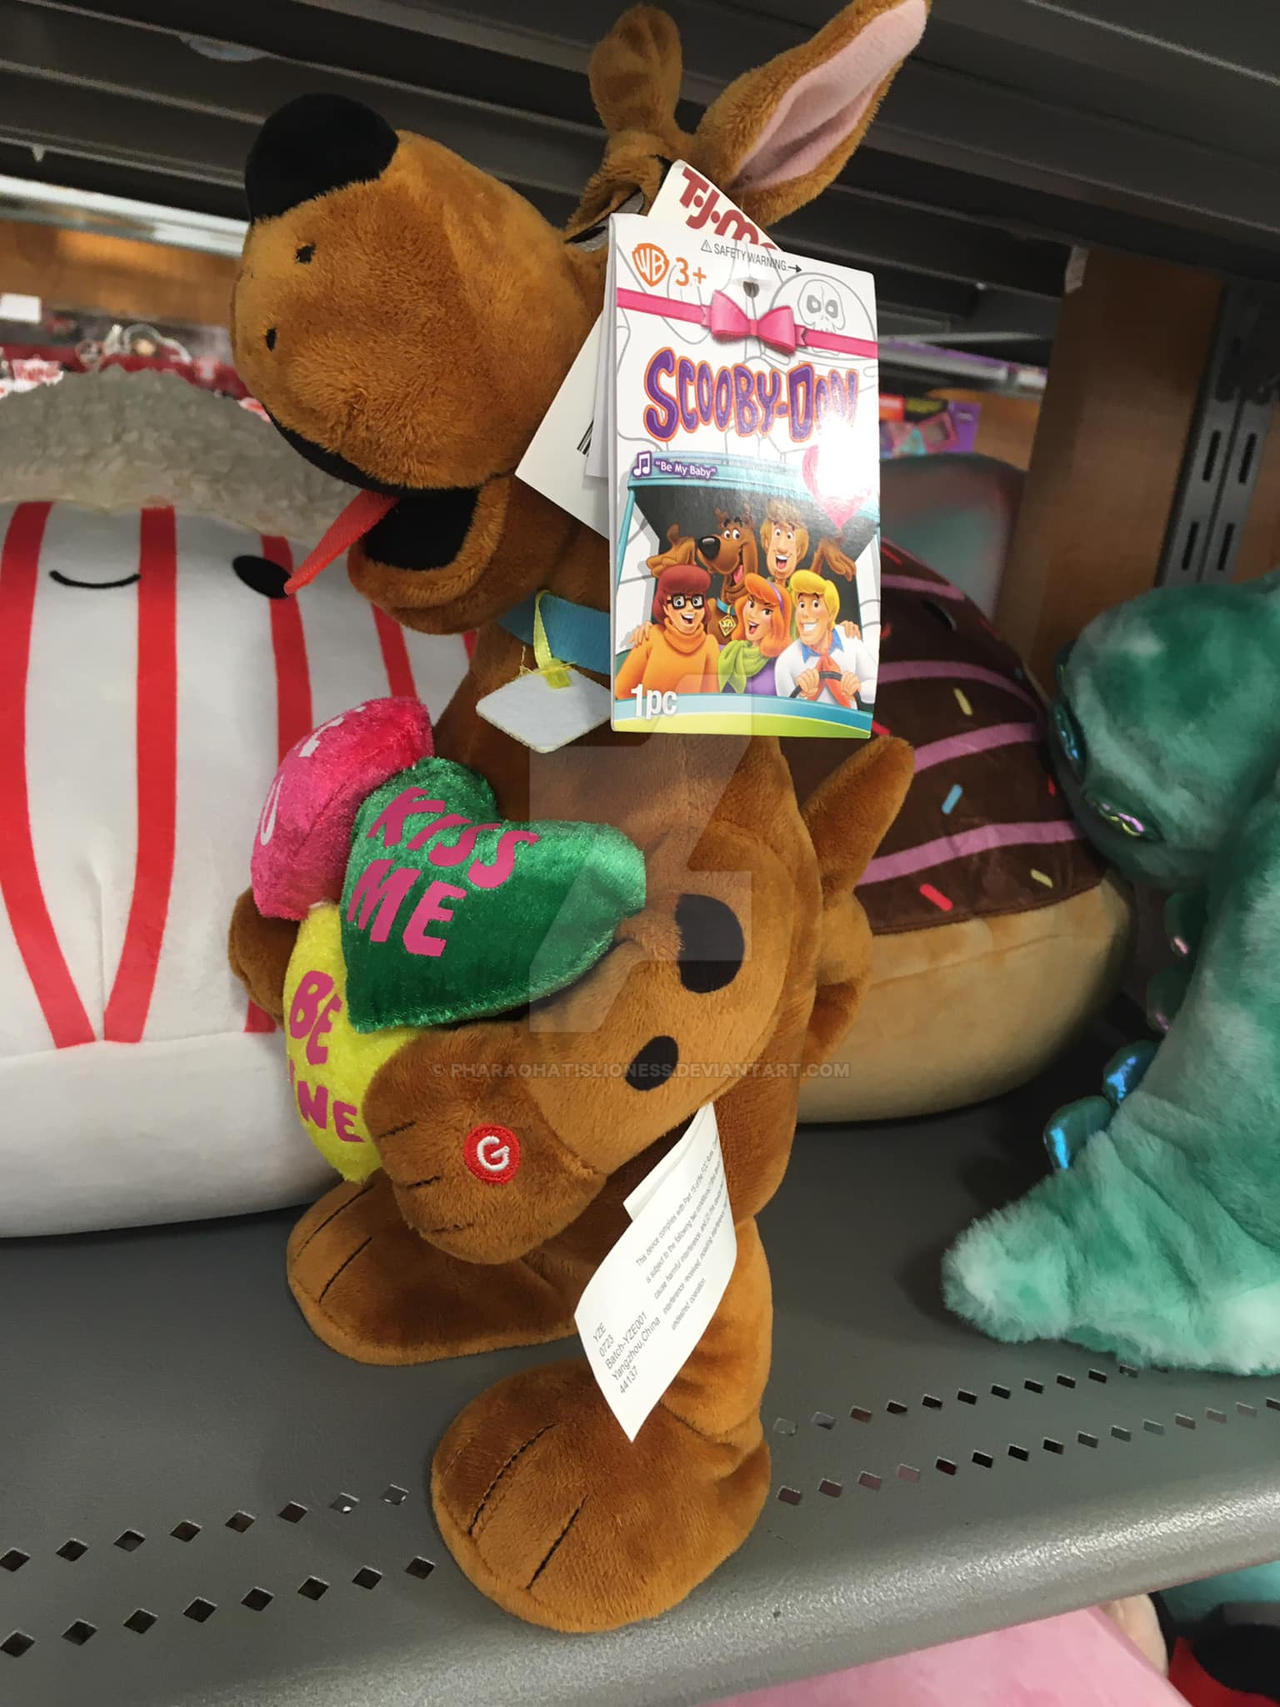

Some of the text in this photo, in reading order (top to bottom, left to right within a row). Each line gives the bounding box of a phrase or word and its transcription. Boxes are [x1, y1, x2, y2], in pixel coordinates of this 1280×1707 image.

[634, 245, 667, 285] WB
[675, 257, 707, 286] 3+
[714, 243, 787, 271] SAFETY WARNING
[674, 464, 687, 476] My
[631, 684, 677, 720] 1pc
[366, 786, 539, 890] KISS
[345, 858, 468, 958] ME
[289, 970, 342, 1066] BE
[476, 1135, 510, 1172] G
[592, 1322, 607, 1342] YZE
[599, 1334, 614, 1357] 0723
[620, 1365, 638, 1393] 44137
